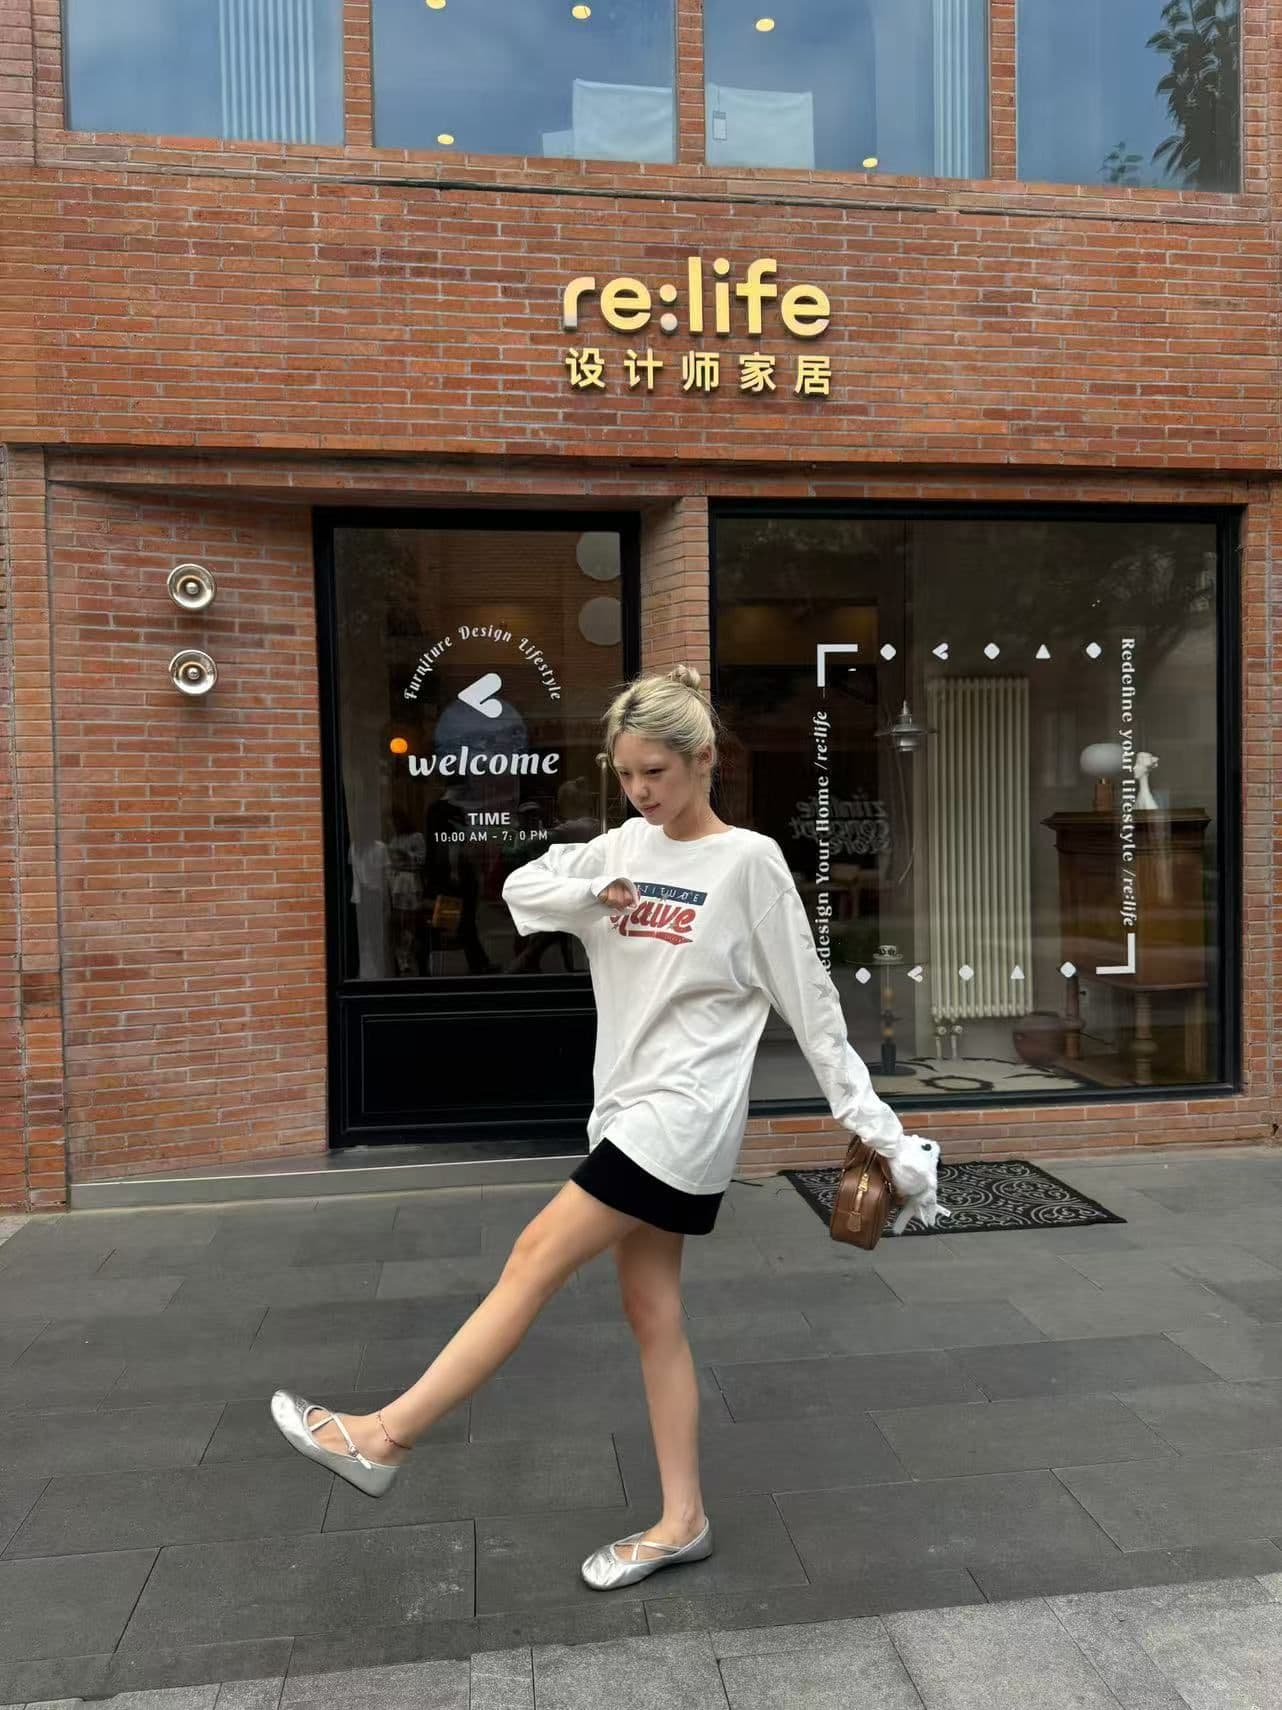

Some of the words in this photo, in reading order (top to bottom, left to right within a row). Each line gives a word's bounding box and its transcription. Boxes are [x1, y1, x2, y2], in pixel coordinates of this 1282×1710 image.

[563, 256, 831, 338] re:life
[565, 347, 832, 396] 设计师家居
[404, 636, 453, 699] Furniture
[458, 624, 513, 643] Design
[518, 637, 561, 700] Lifestyle
[1120, 638, 1136, 723] Redefine
[408, 745, 560, 776] welcome
[1119, 729, 1136, 772] your
[467, 812, 511, 826] TIME
[815, 776, 830, 832] Home
[1119, 780, 1136, 862] lifestyle
[434, 831, 466, 842] 10:00
[469, 831, 488, 842] AM
[530, 830, 548, 841] PM
[815, 840, 830, 884] Your
[814, 892, 833, 976] edesign
